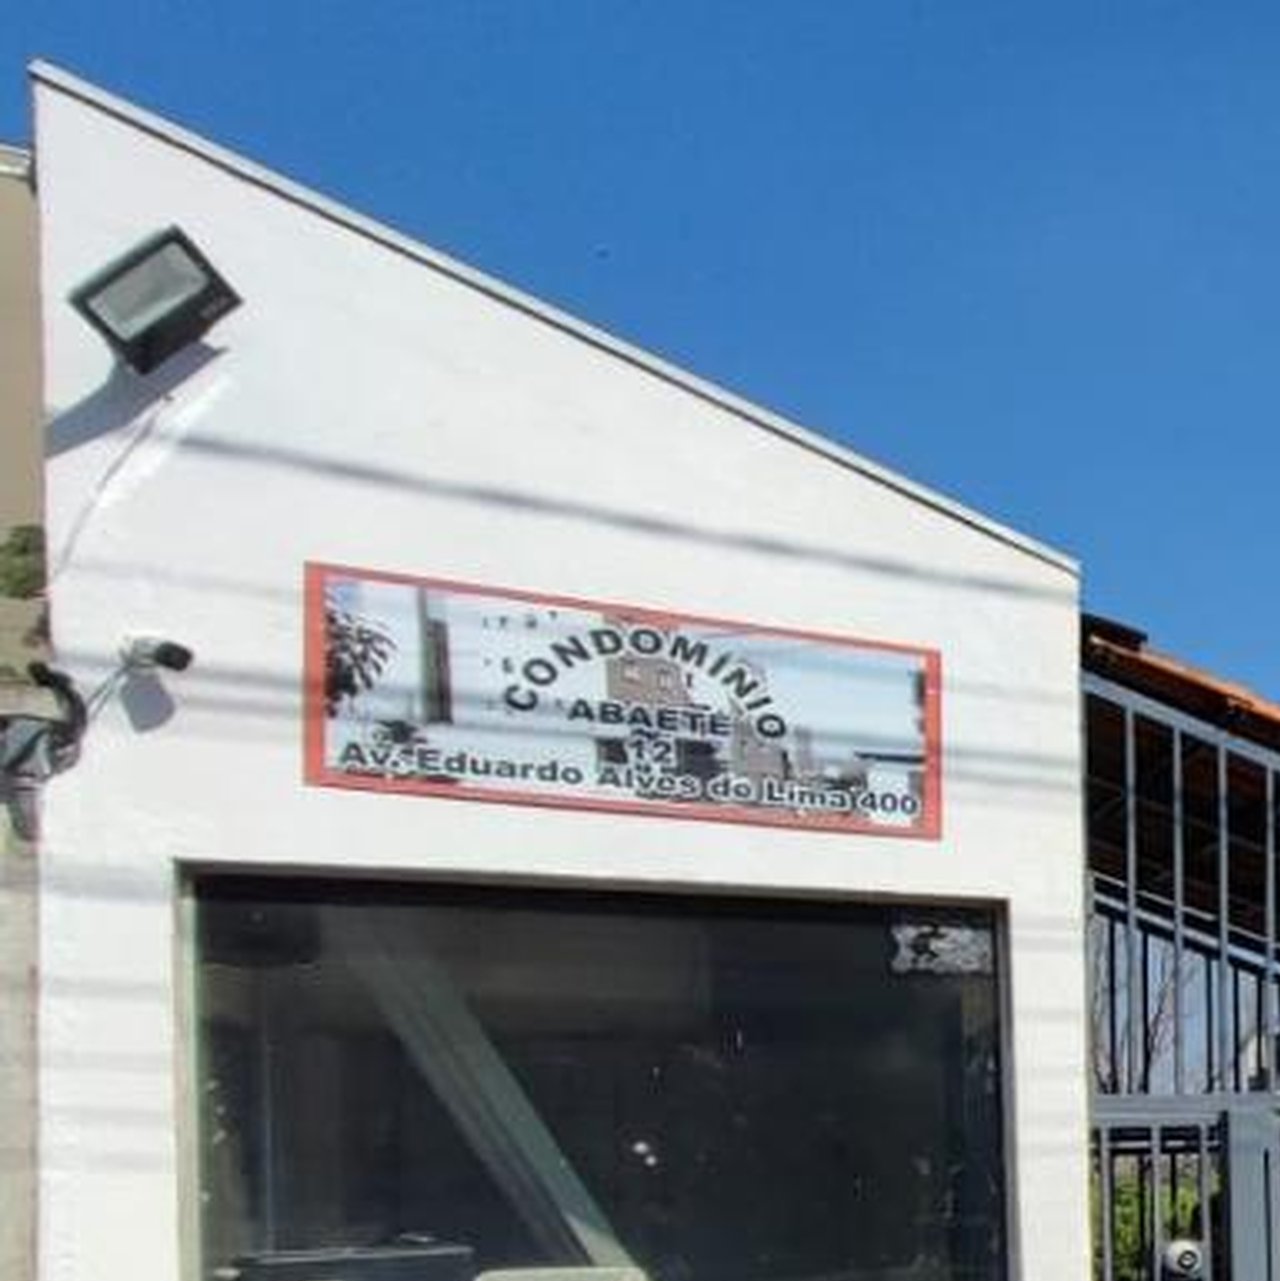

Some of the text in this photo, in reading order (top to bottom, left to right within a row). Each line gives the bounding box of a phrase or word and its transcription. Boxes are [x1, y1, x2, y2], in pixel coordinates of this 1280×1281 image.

[417, 748, 583, 784] Eduardo
[767, 780, 847, 810] Lima
[859, 792, 919, 815] 400
